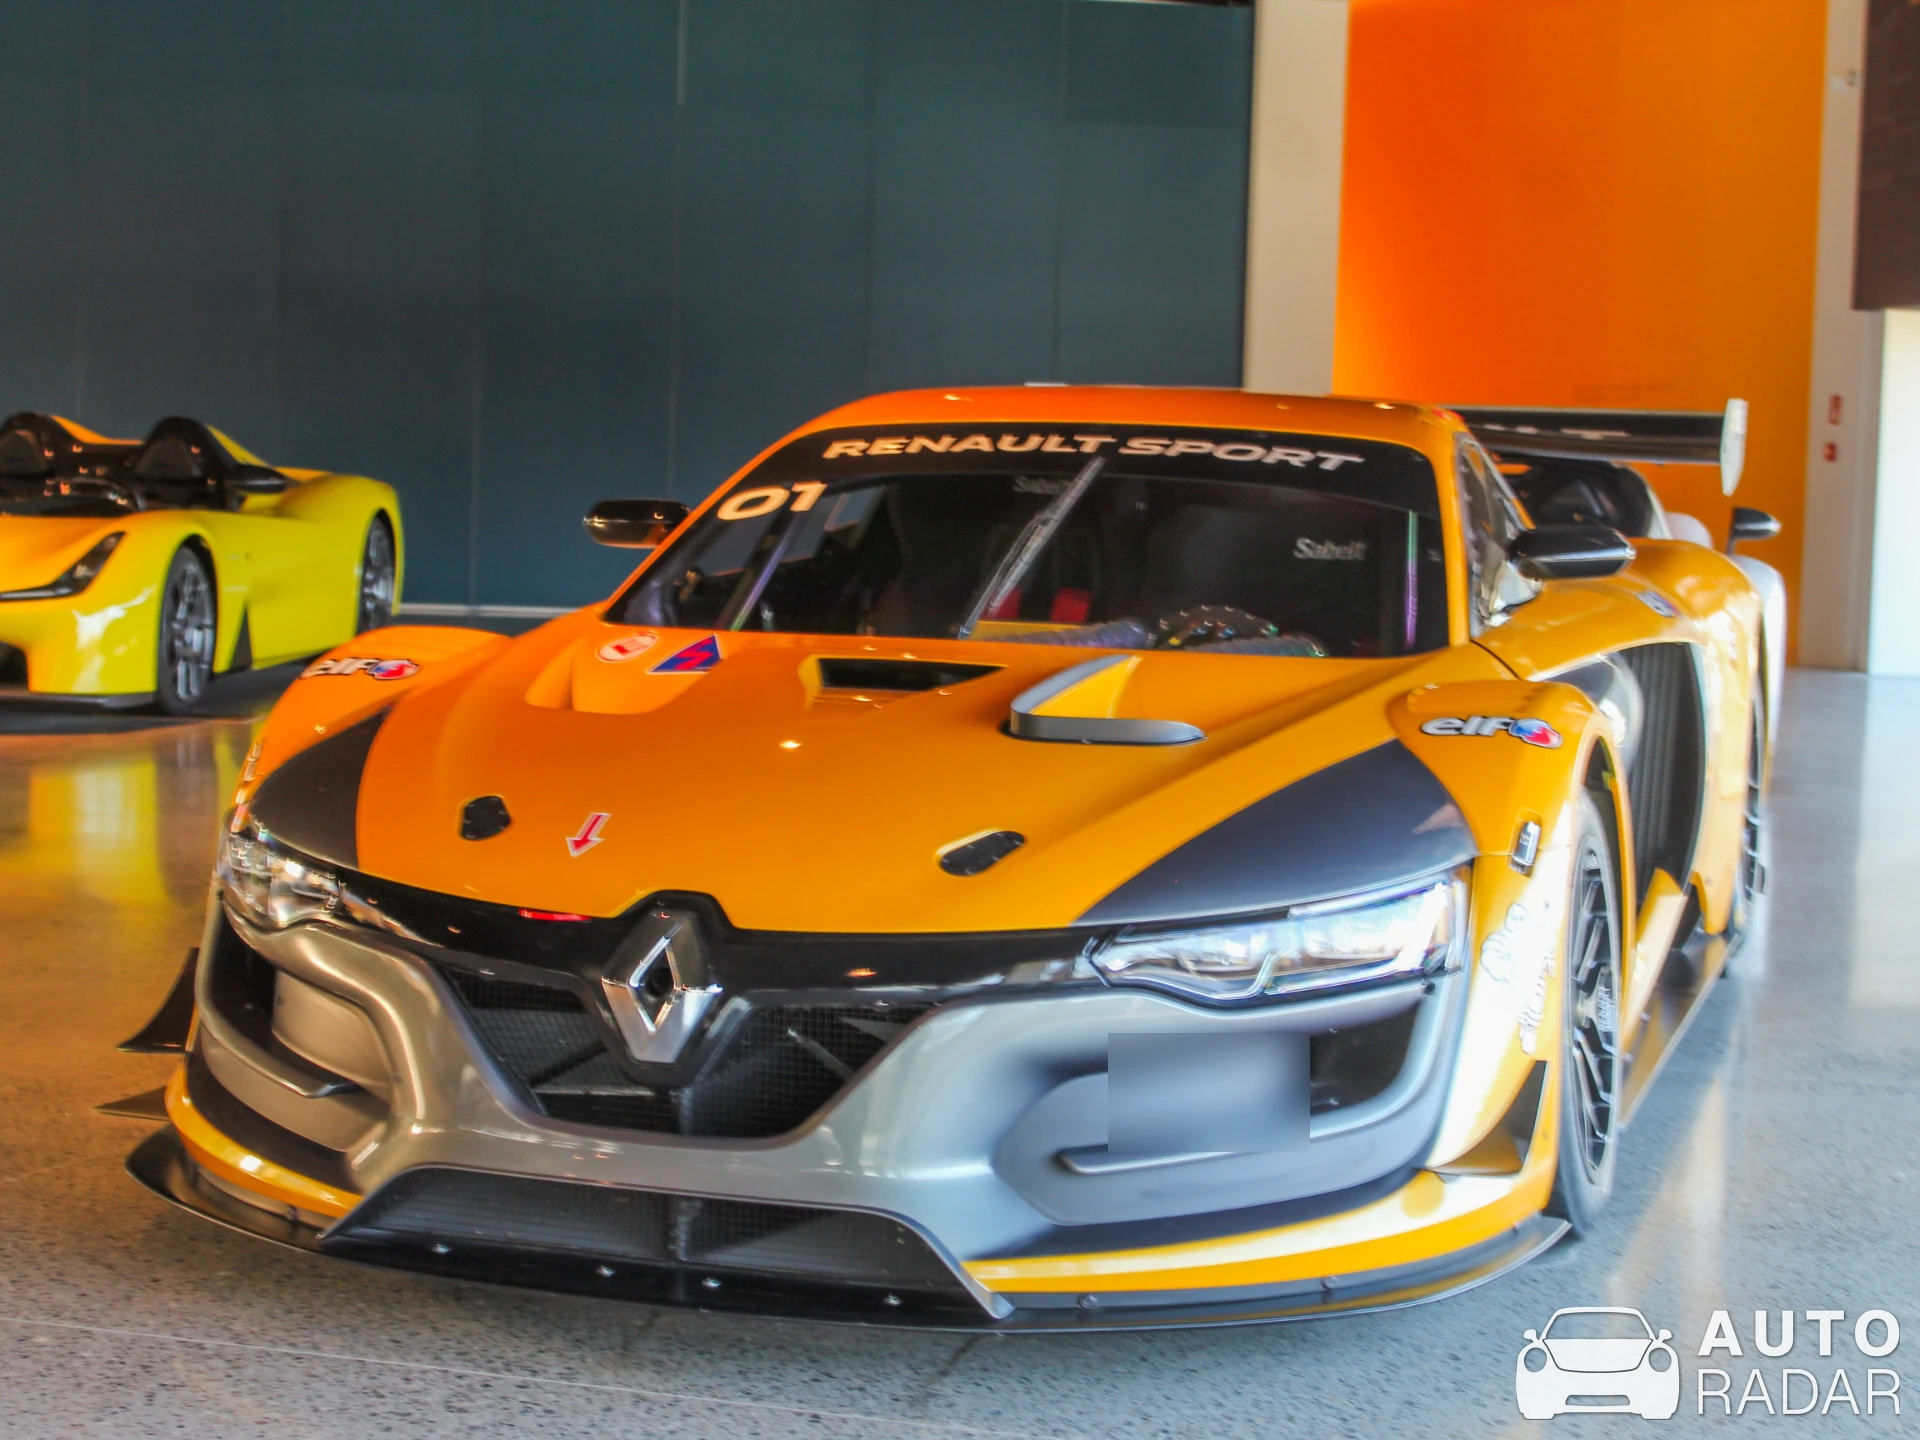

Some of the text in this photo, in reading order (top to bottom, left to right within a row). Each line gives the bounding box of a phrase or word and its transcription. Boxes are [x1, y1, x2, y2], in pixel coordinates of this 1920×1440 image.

[823, 433, 1365, 471] RENAULT SPORT
[717, 481, 828, 521] 01
